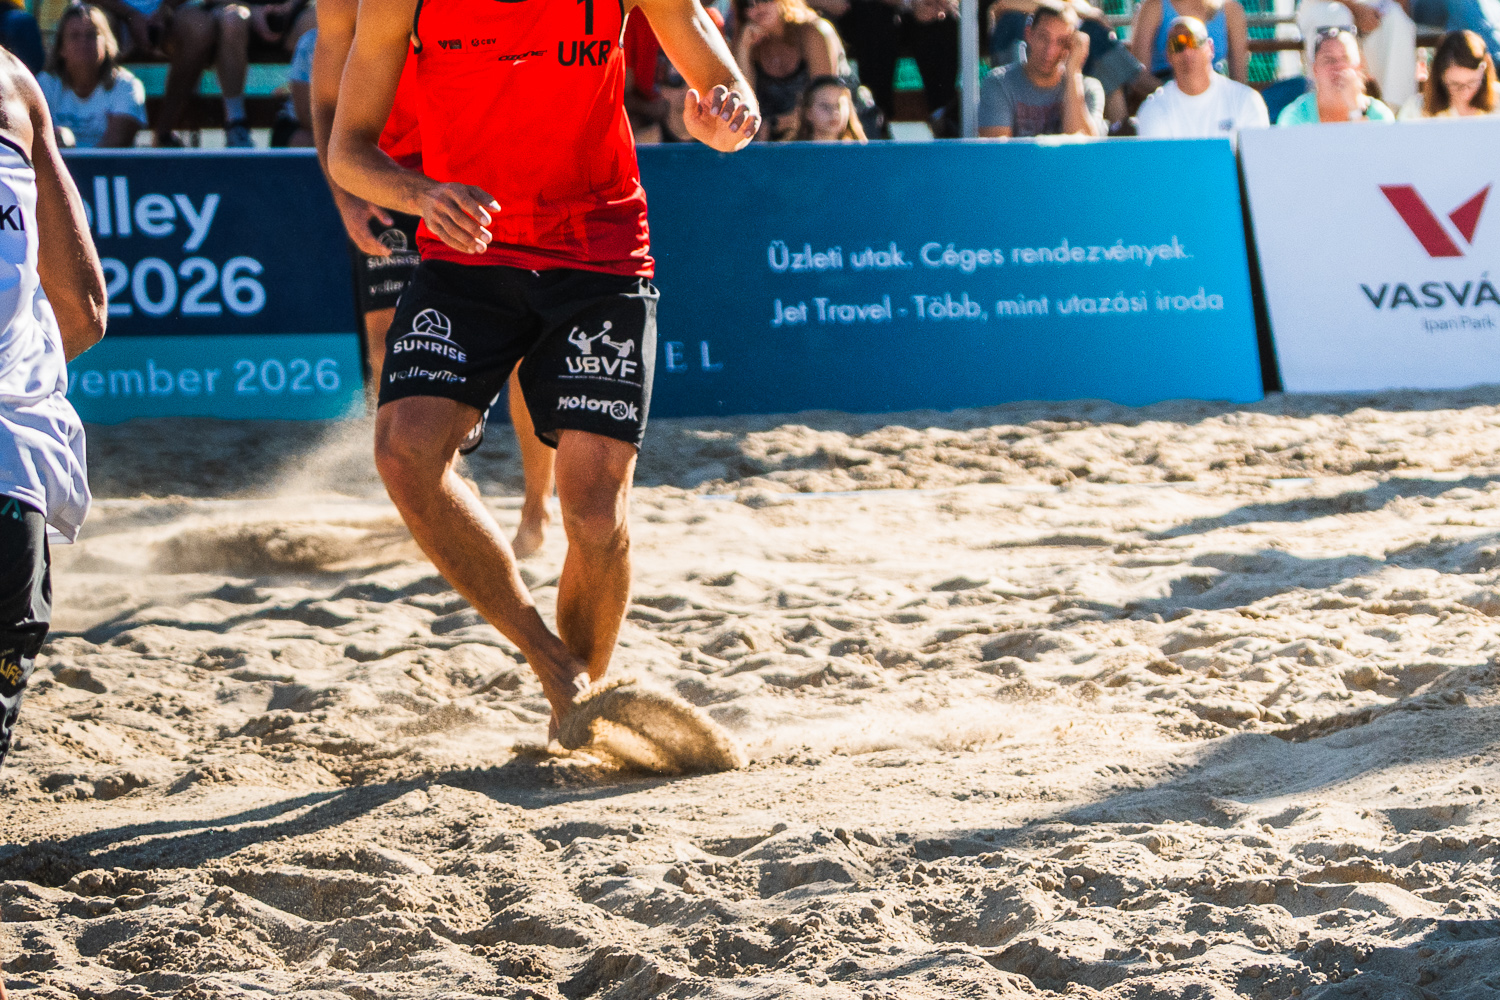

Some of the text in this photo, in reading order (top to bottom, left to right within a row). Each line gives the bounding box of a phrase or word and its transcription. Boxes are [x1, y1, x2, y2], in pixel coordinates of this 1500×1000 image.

[558, 40, 611, 67] UKR
[768, 234, 1193, 273] Üzleti utak. Céges rendezvények.
[104, 257, 266, 316] 2026
[770, 298, 808, 328] Jet
[812, 294, 892, 324] Travel
[913, 292, 989, 322] Több,
[996, 292, 1050, 316] mint
[1056, 289, 1149, 315] utazási
[1155, 286, 1225, 311] iroda
[1460, 313, 1496, 330] Park
[393, 339, 467, 363] SUNRISE
[566, 356, 638, 377] UBVF
[234, 358, 342, 395] 2026
